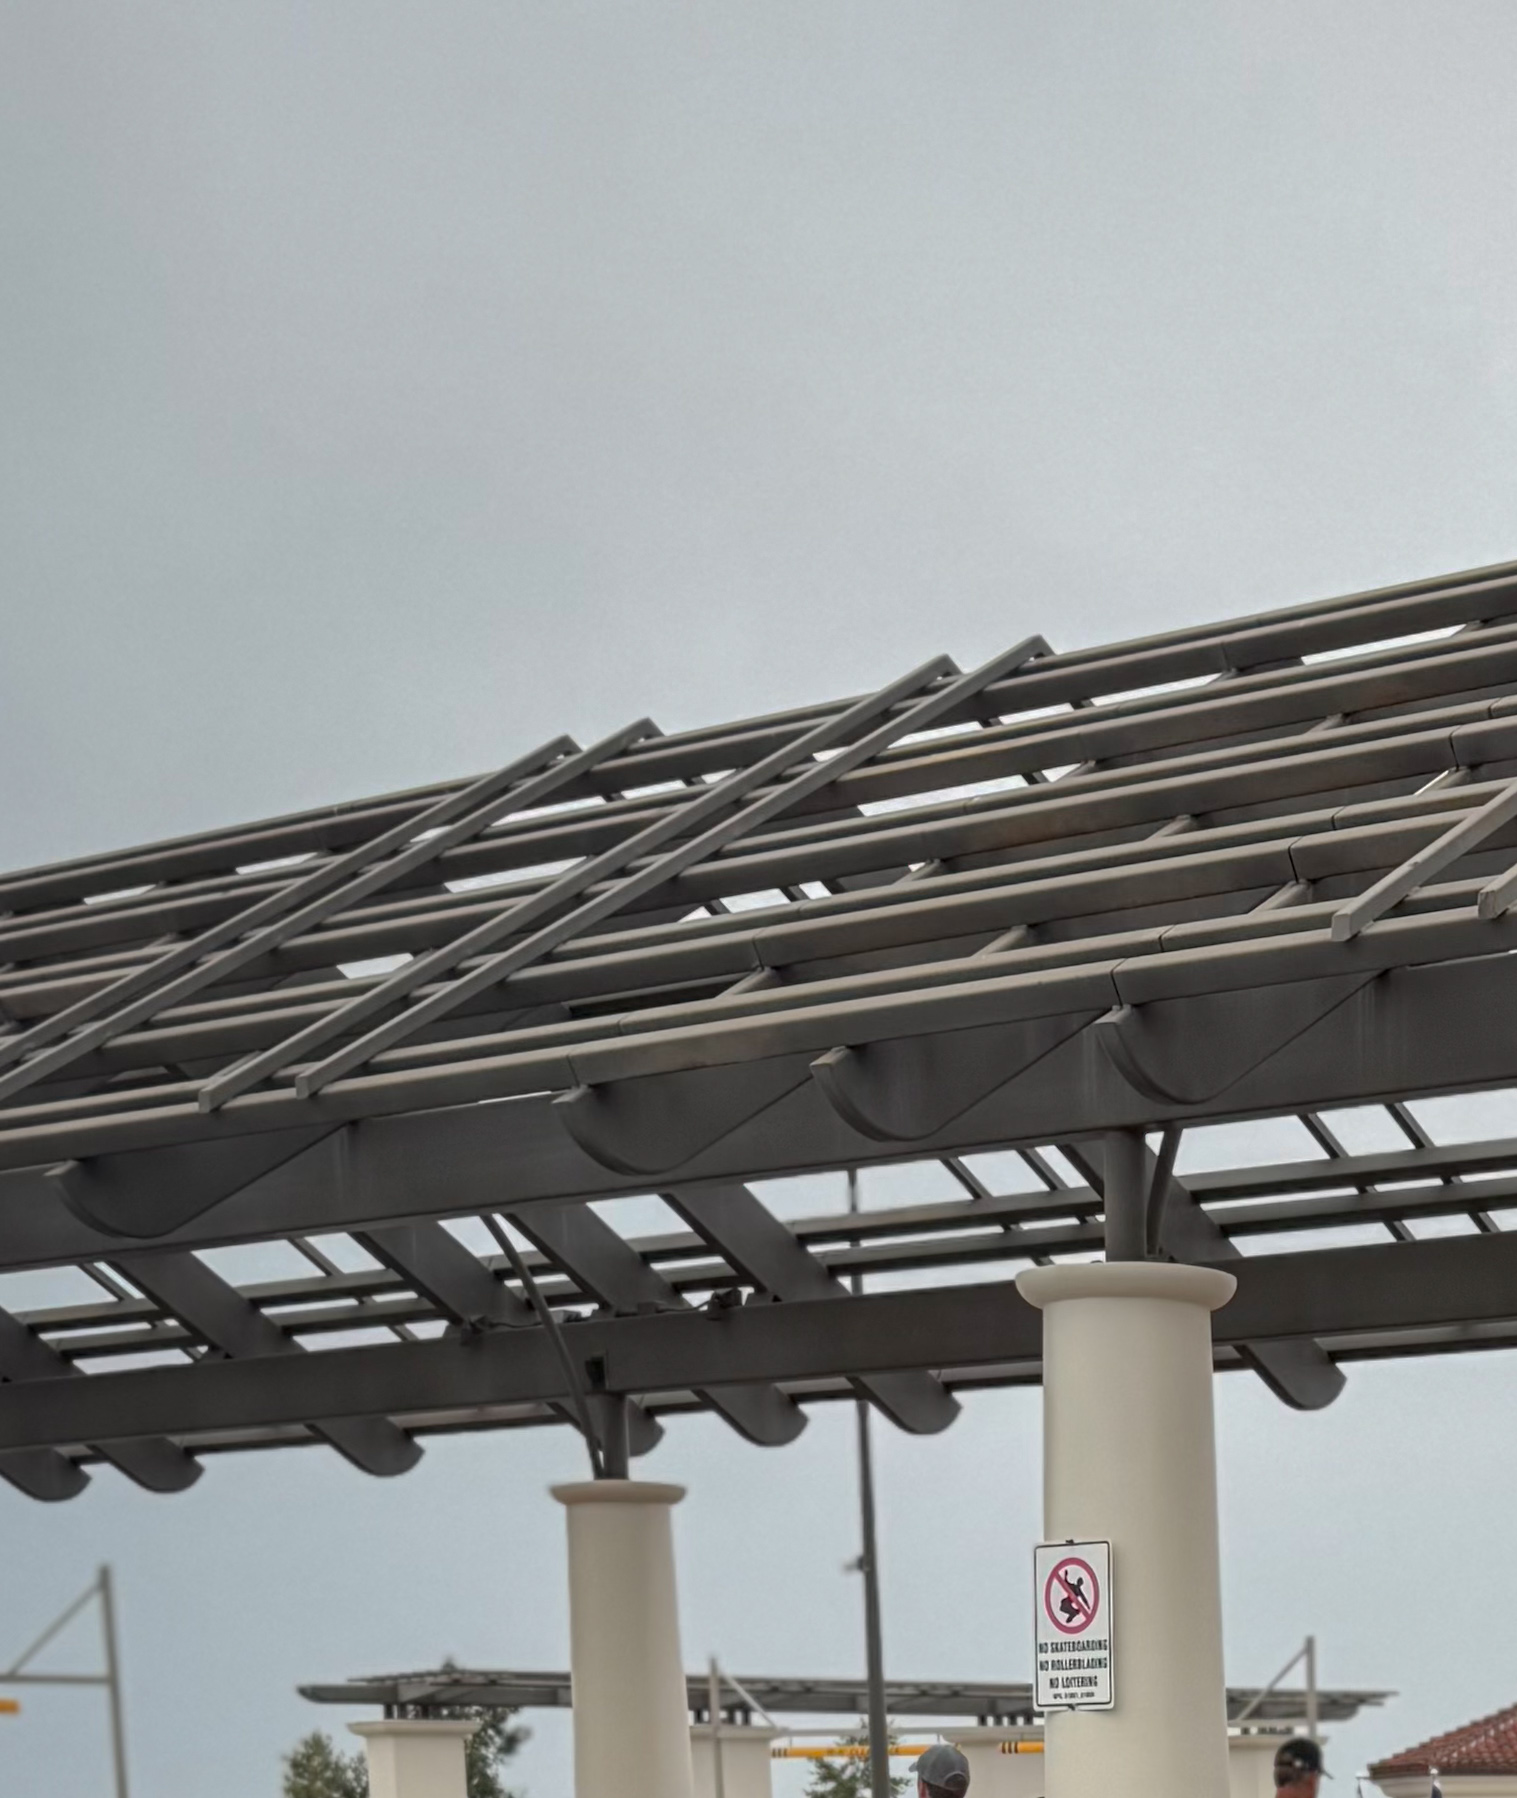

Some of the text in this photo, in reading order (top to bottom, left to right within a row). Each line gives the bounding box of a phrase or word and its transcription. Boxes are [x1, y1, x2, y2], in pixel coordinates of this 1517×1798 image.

[1039, 1639, 1107, 1653] NO SKATEBOARDING
[1040, 1657, 1107, 1671] NO ROLLERBLADING
[1049, 1675, 1098, 1689] NO LOITERING
